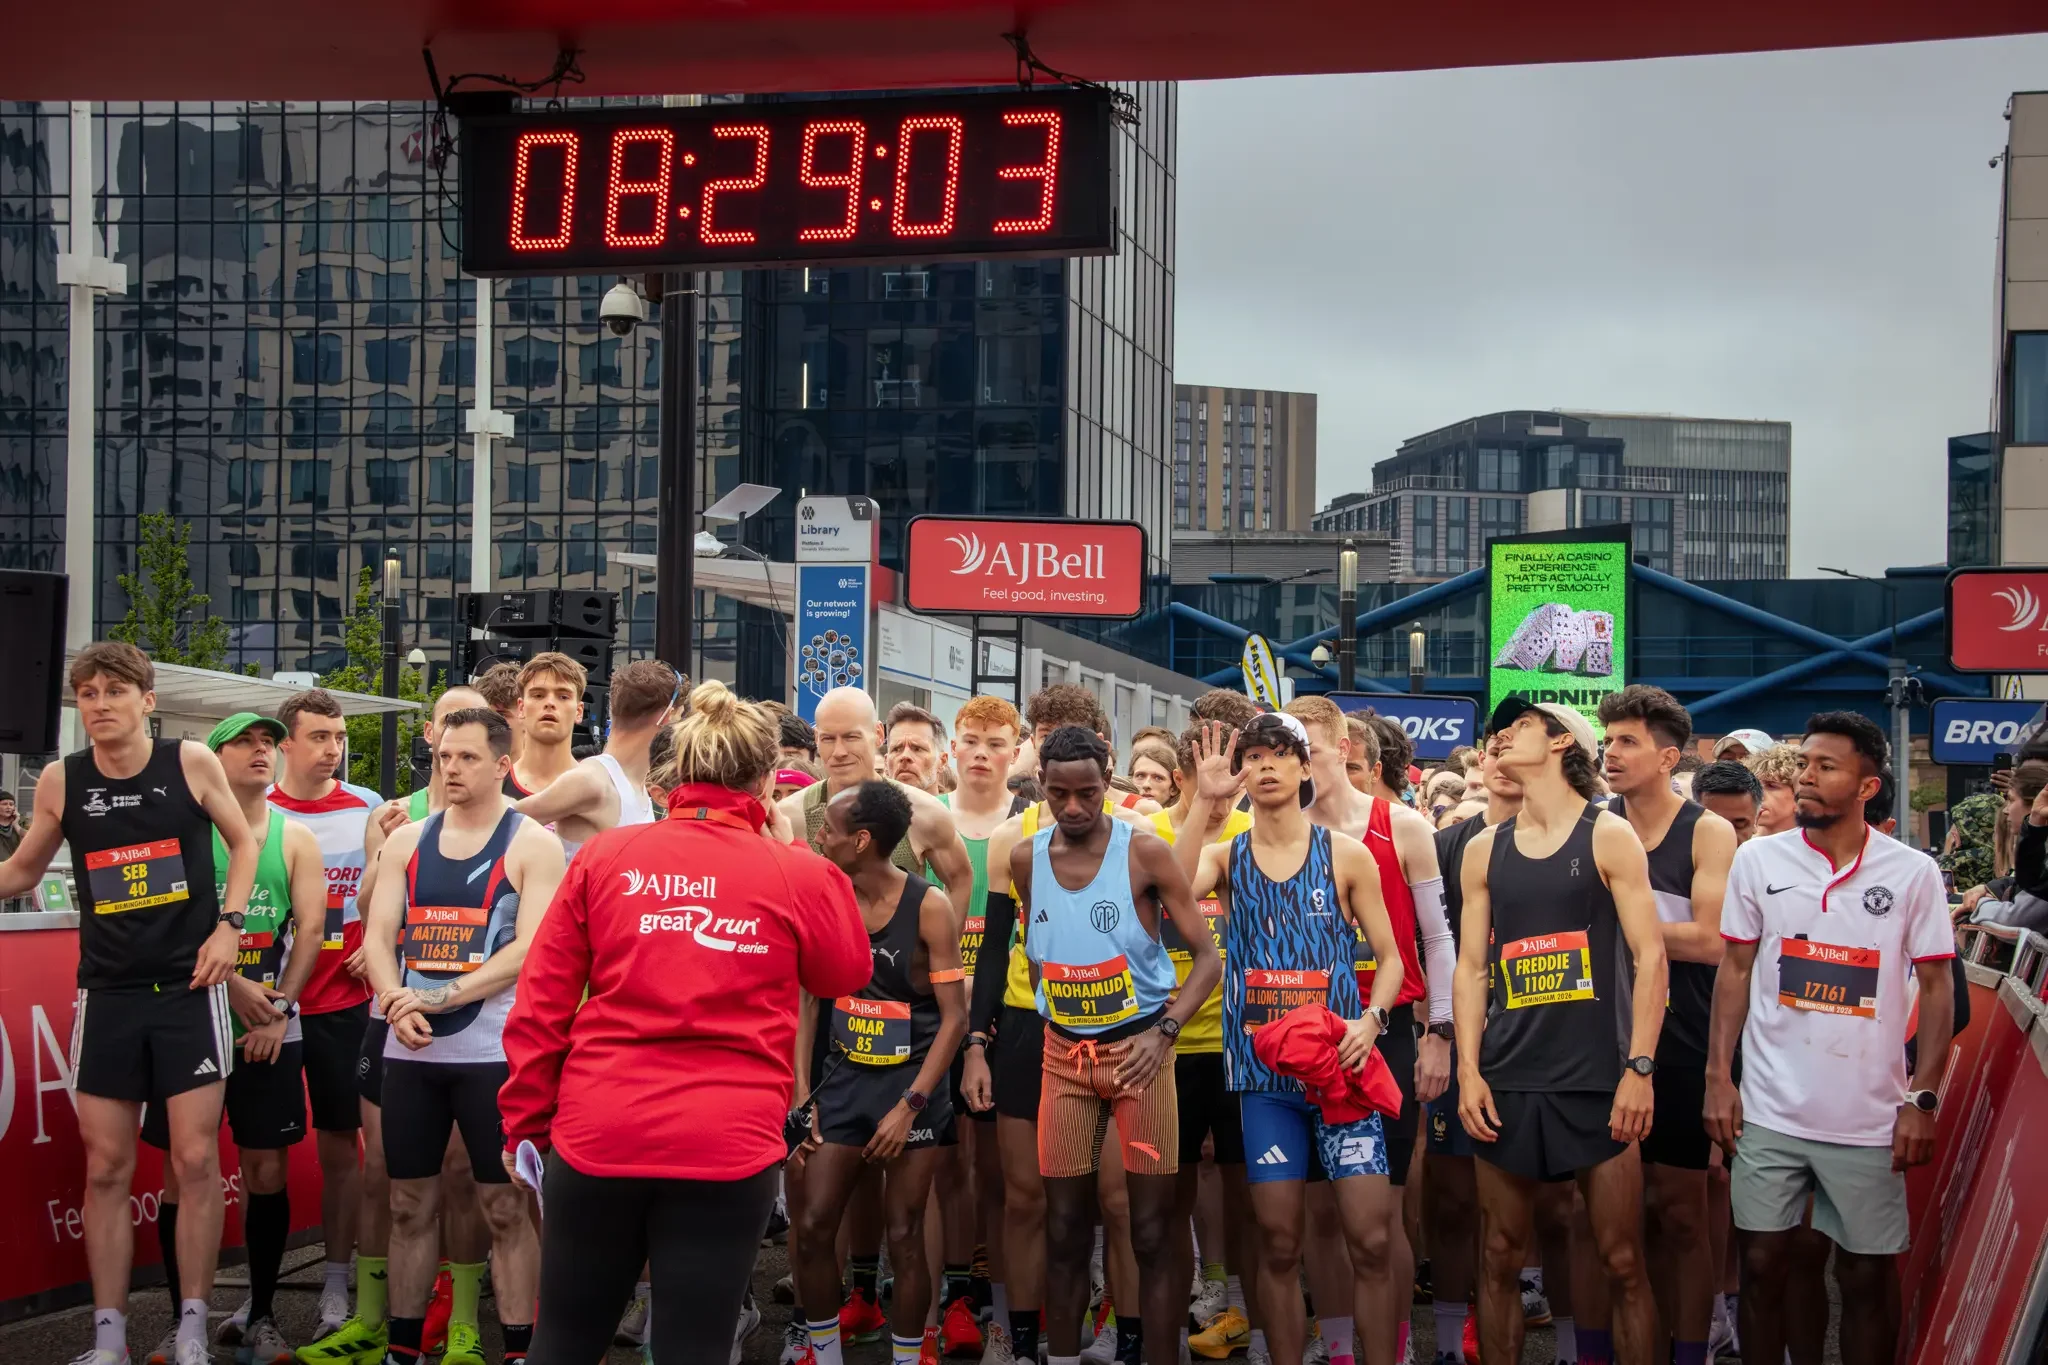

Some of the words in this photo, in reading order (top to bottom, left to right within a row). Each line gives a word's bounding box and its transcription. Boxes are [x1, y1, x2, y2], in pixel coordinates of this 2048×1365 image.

[510, 112, 1061, 249] 08:29:03
[858, 507, 863, 516] 1
[801, 525, 840, 536] Library
[1505, 553, 1555, 562] FINALLY,
[1557, 553, 1566, 561] A
[1566, 553, 1612, 561] CASINO
[1519, 563, 1597, 572] EXPERIENCE
[1505, 574, 1548, 582] THAT'S
[1548, 574, 1613, 582] ACTUALLY
[983, 588, 1008, 599] Feel
[1011, 590, 1046, 602] good,
[1050, 590, 1107, 604] investing.
[1506, 584, 1556, 593] PRETTY
[1556, 584, 1610, 592] SMOOTH
[814, 610, 850, 618] growing!
[1250, 644, 1262, 679] FAST
[122, 863, 148, 881] SEB
[128, 881, 148, 897] 40
[114, 898, 152, 911] BIRMINGHAM
[639, 912, 693, 934] great
[713, 917, 758, 936] run
[412, 926, 474, 942] MATTHEW
[421, 943, 459, 960] 11683
[737, 942, 769, 954] series
[448, 962, 463, 970] 2026
[1516, 953, 1570, 976] FREDDIE
[1051, 976, 1124, 998] MOHAMUD
[1524, 973, 1565, 994] 11007
[1246, 989, 1256, 1004] KA
[1257, 990, 1278, 1005] LONG
[1281, 990, 1327, 1006] THOMPSON
[1520, 994, 1556, 1005] BIRMINGHAM
[1557, 992, 1573, 1000] 2026
[1804, 981, 1847, 1002] 17161
[1081, 999, 1097, 1014] 91
[1795, 999, 1835, 1013] BIRMINGHAM
[847, 1016, 885, 1036] OMAR
[1067, 1016, 1104, 1025] BIRMINGHAM
[1105, 1014, 1120, 1023] 2026
[856, 1037, 873, 1052] 85
